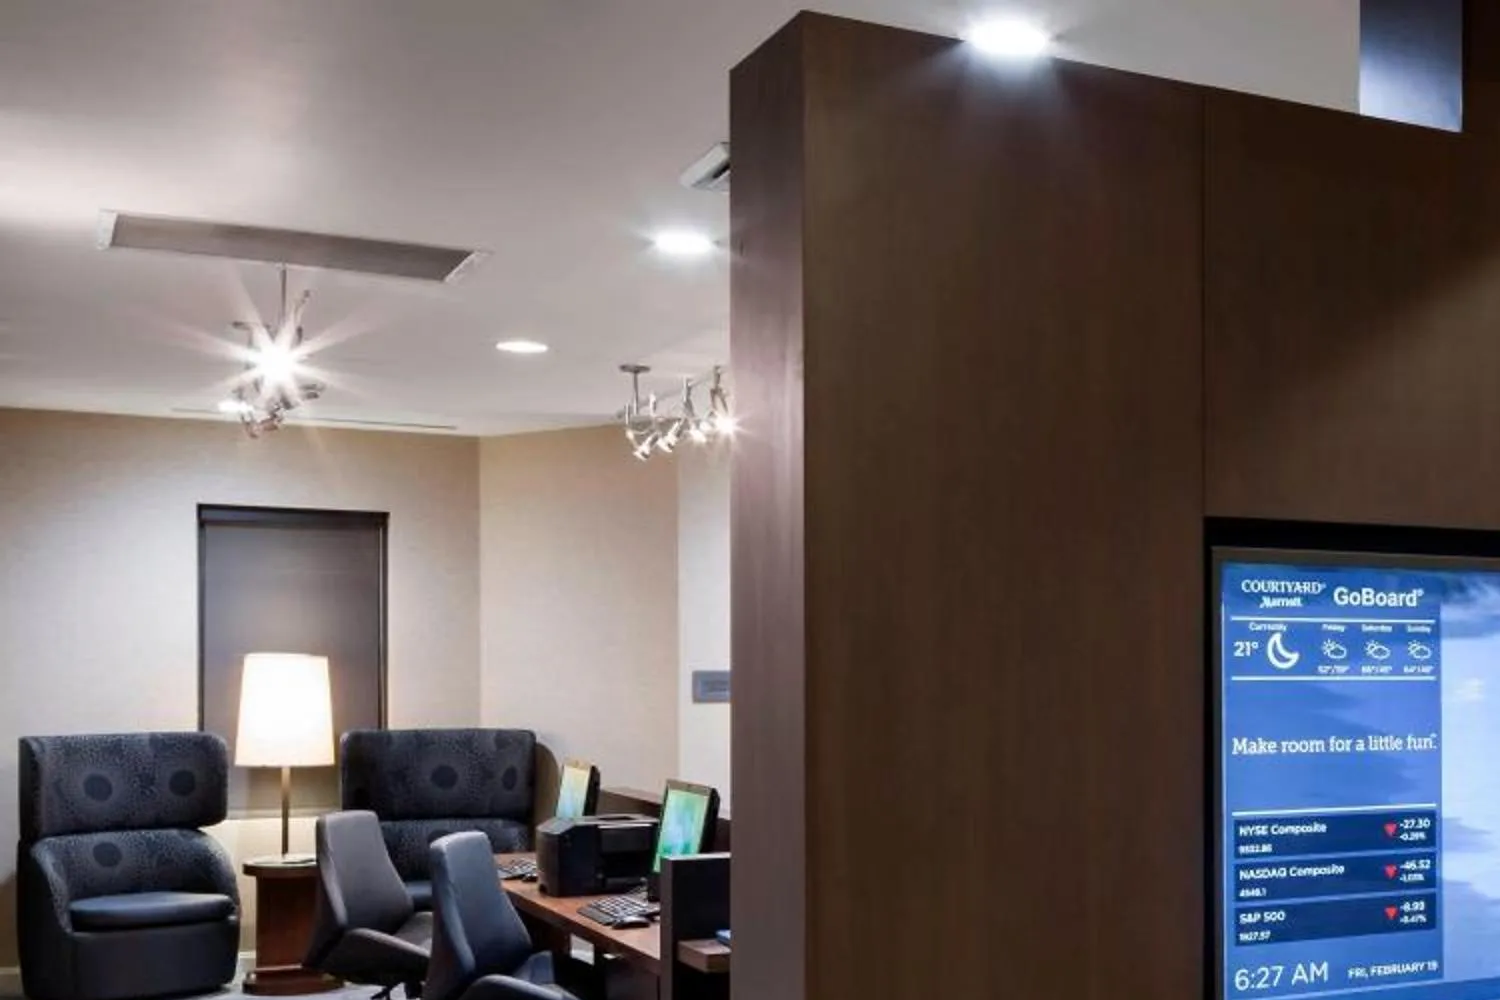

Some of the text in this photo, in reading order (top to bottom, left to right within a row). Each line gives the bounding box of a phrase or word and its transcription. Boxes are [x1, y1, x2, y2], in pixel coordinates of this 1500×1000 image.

[1232, 737, 1279, 755] Make
[1281, 740, 1325, 753] room
[1330, 736, 1352, 752] for
[1356, 739, 1365, 752] a
[1369, 735, 1402, 751] little
[1239, 822, 1327, 837] NYSE Composite
[1239, 864, 1345, 881] NASDAQ Composite
[1239, 911, 1286, 924] S&P 500
[1234, 961, 1329, 991] 6:27 AM
[1348, 960, 1438, 980] FRI, FEBRUARY 19
